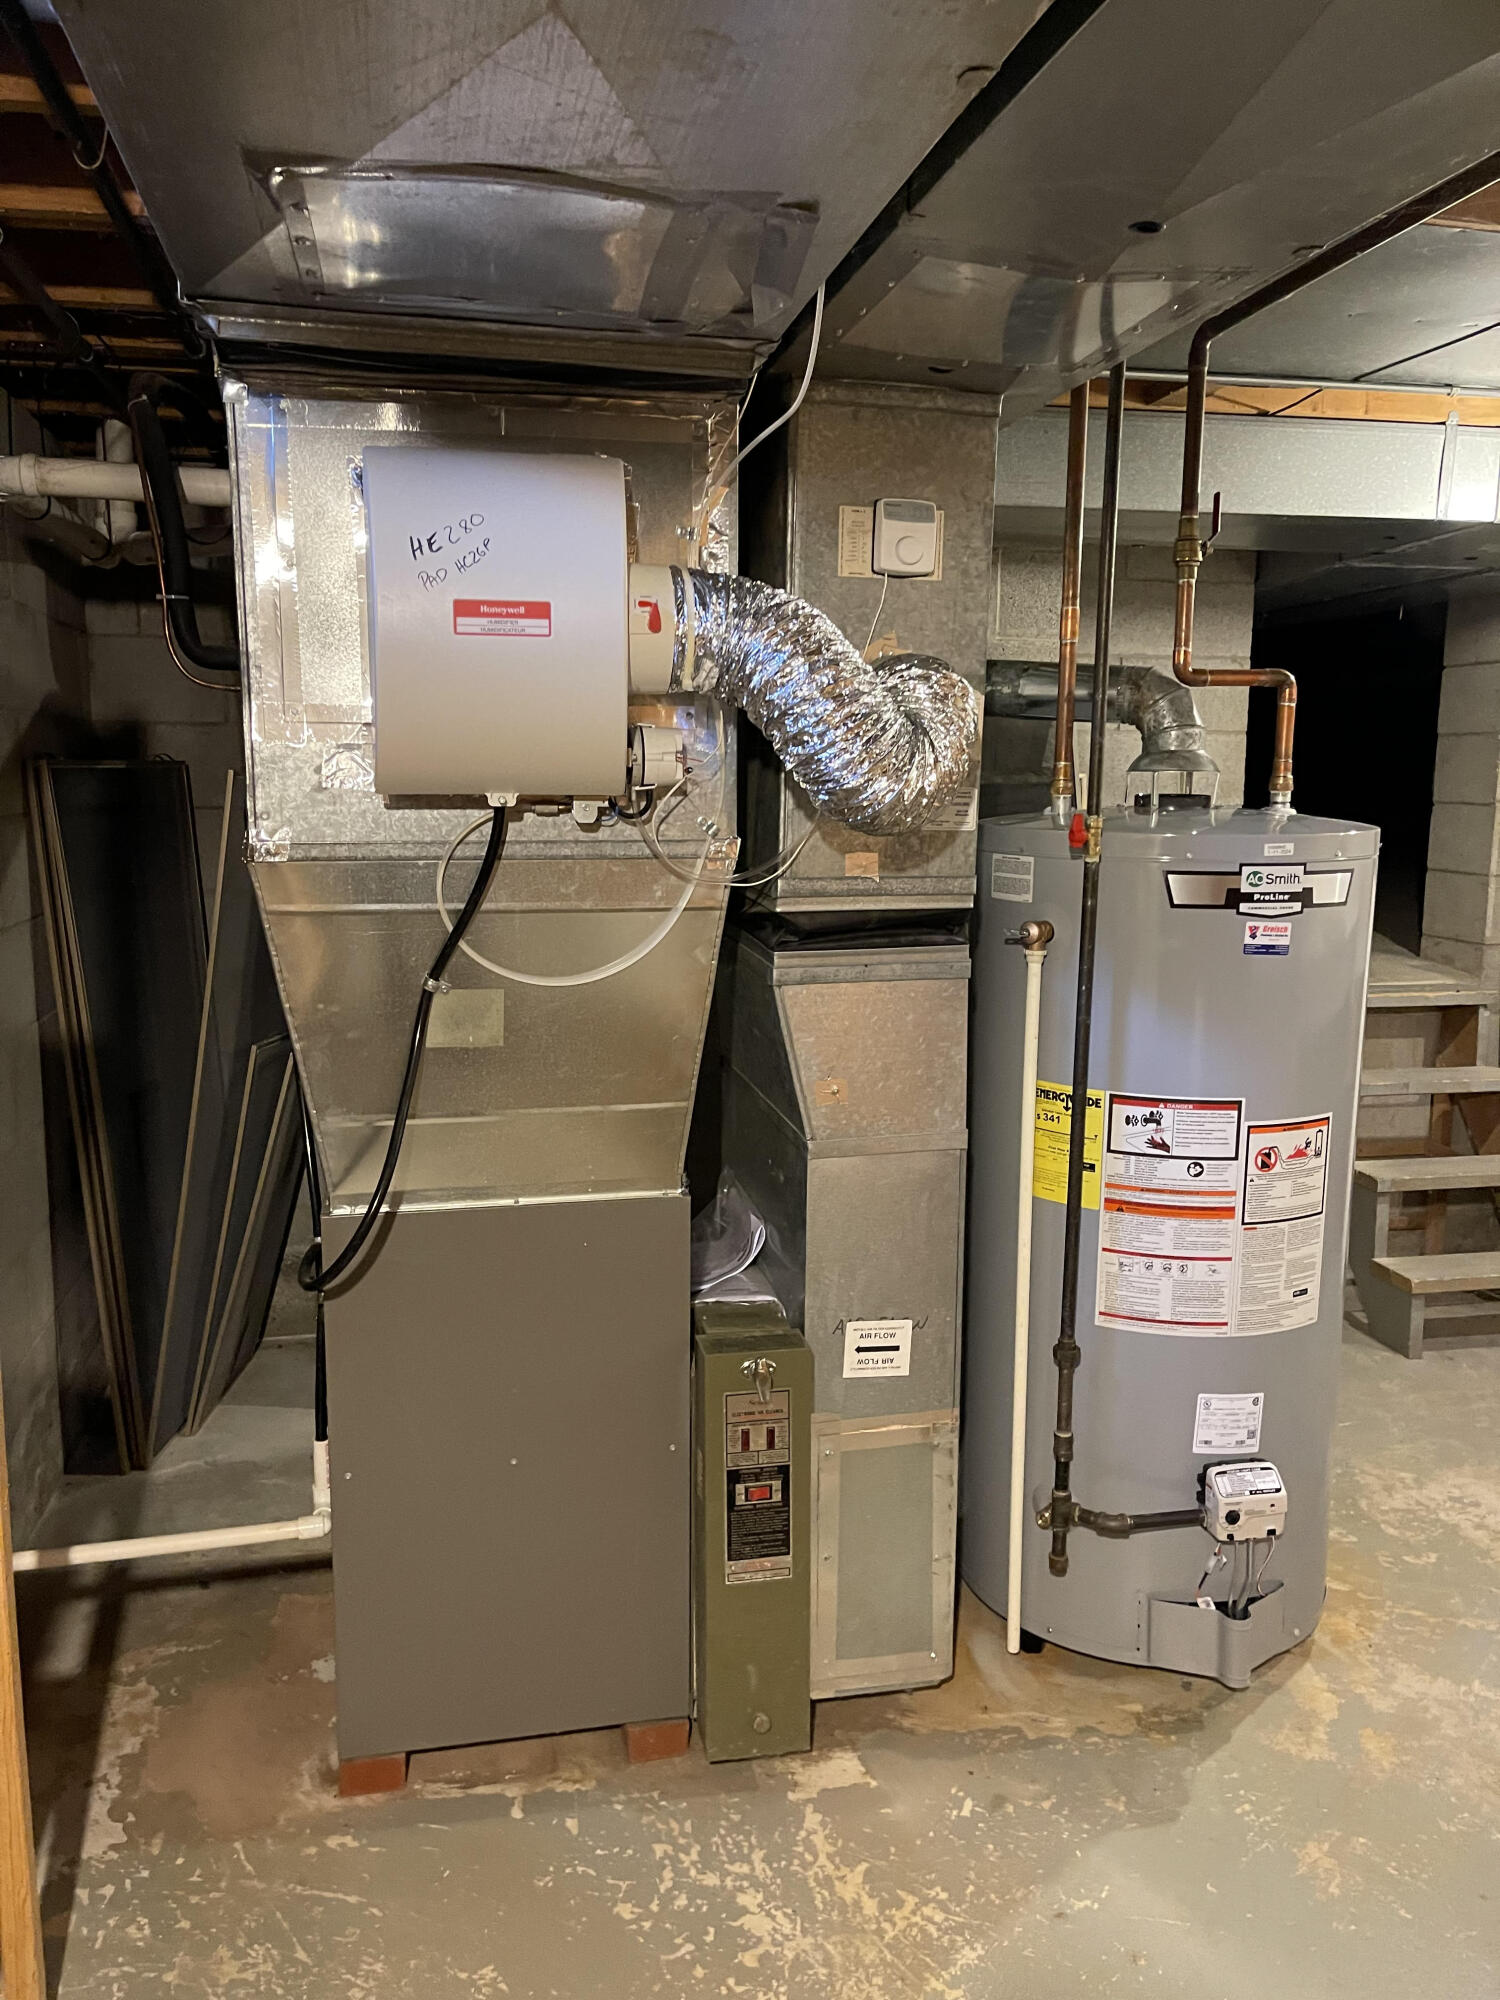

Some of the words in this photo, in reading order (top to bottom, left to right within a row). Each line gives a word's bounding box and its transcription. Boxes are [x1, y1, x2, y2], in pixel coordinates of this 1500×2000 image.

[418, 568, 448, 592] PAD
[480, 604, 525, 615] Honeywell
[1265, 873, 1300, 885] Smith
[1253, 893, 1290, 901] ProLine
[881, 1357, 895, 1365] AIR
